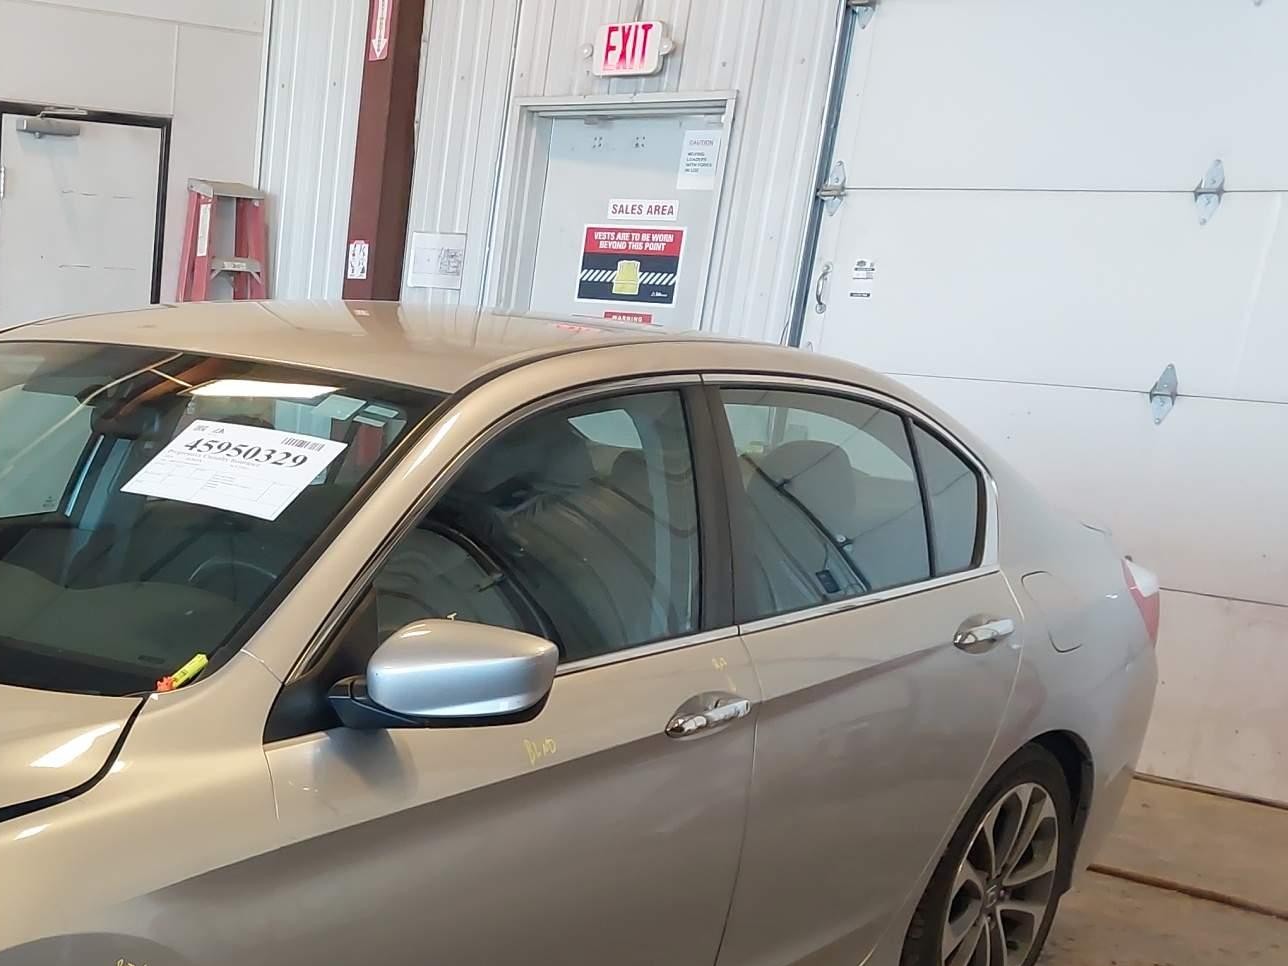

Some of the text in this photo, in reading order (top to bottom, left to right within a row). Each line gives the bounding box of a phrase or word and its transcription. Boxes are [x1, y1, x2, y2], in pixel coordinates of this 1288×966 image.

[604, 23, 653, 70] EXIT
[611, 204, 675, 216] SALES AREA
[594, 231, 674, 242] VESTS ARE TO BE WORN
[599, 241, 666, 251] BEYOND THIS POINT
[184, 437, 309, 468] 45950329
